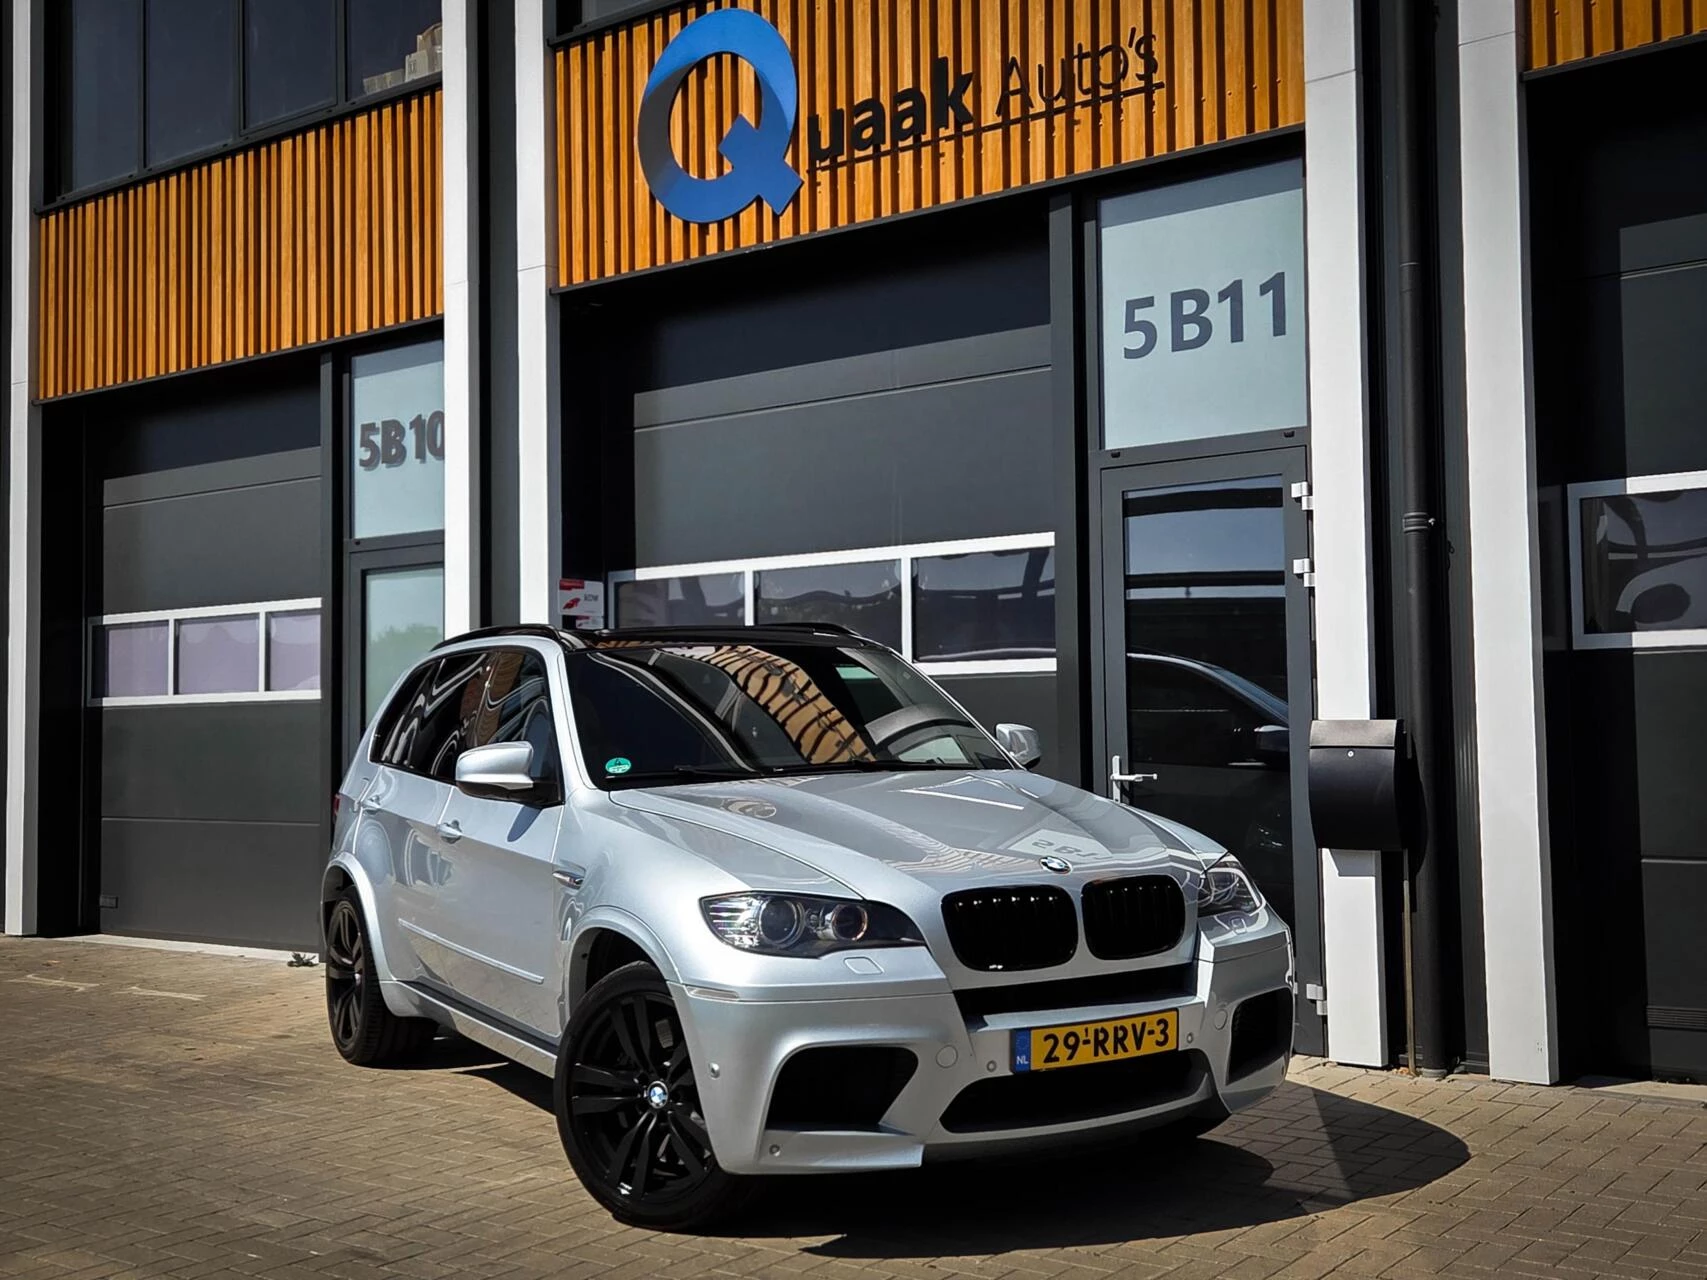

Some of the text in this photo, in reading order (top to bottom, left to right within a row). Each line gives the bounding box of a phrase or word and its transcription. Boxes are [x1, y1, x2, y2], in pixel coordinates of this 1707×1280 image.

[637, 8, 1159, 224] Quaak Auto's
[1123, 271, 1287, 360] 5B11
[359, 410, 445, 471] 5B10
[1016, 1018, 1169, 1065] NL 29-RRV-3
